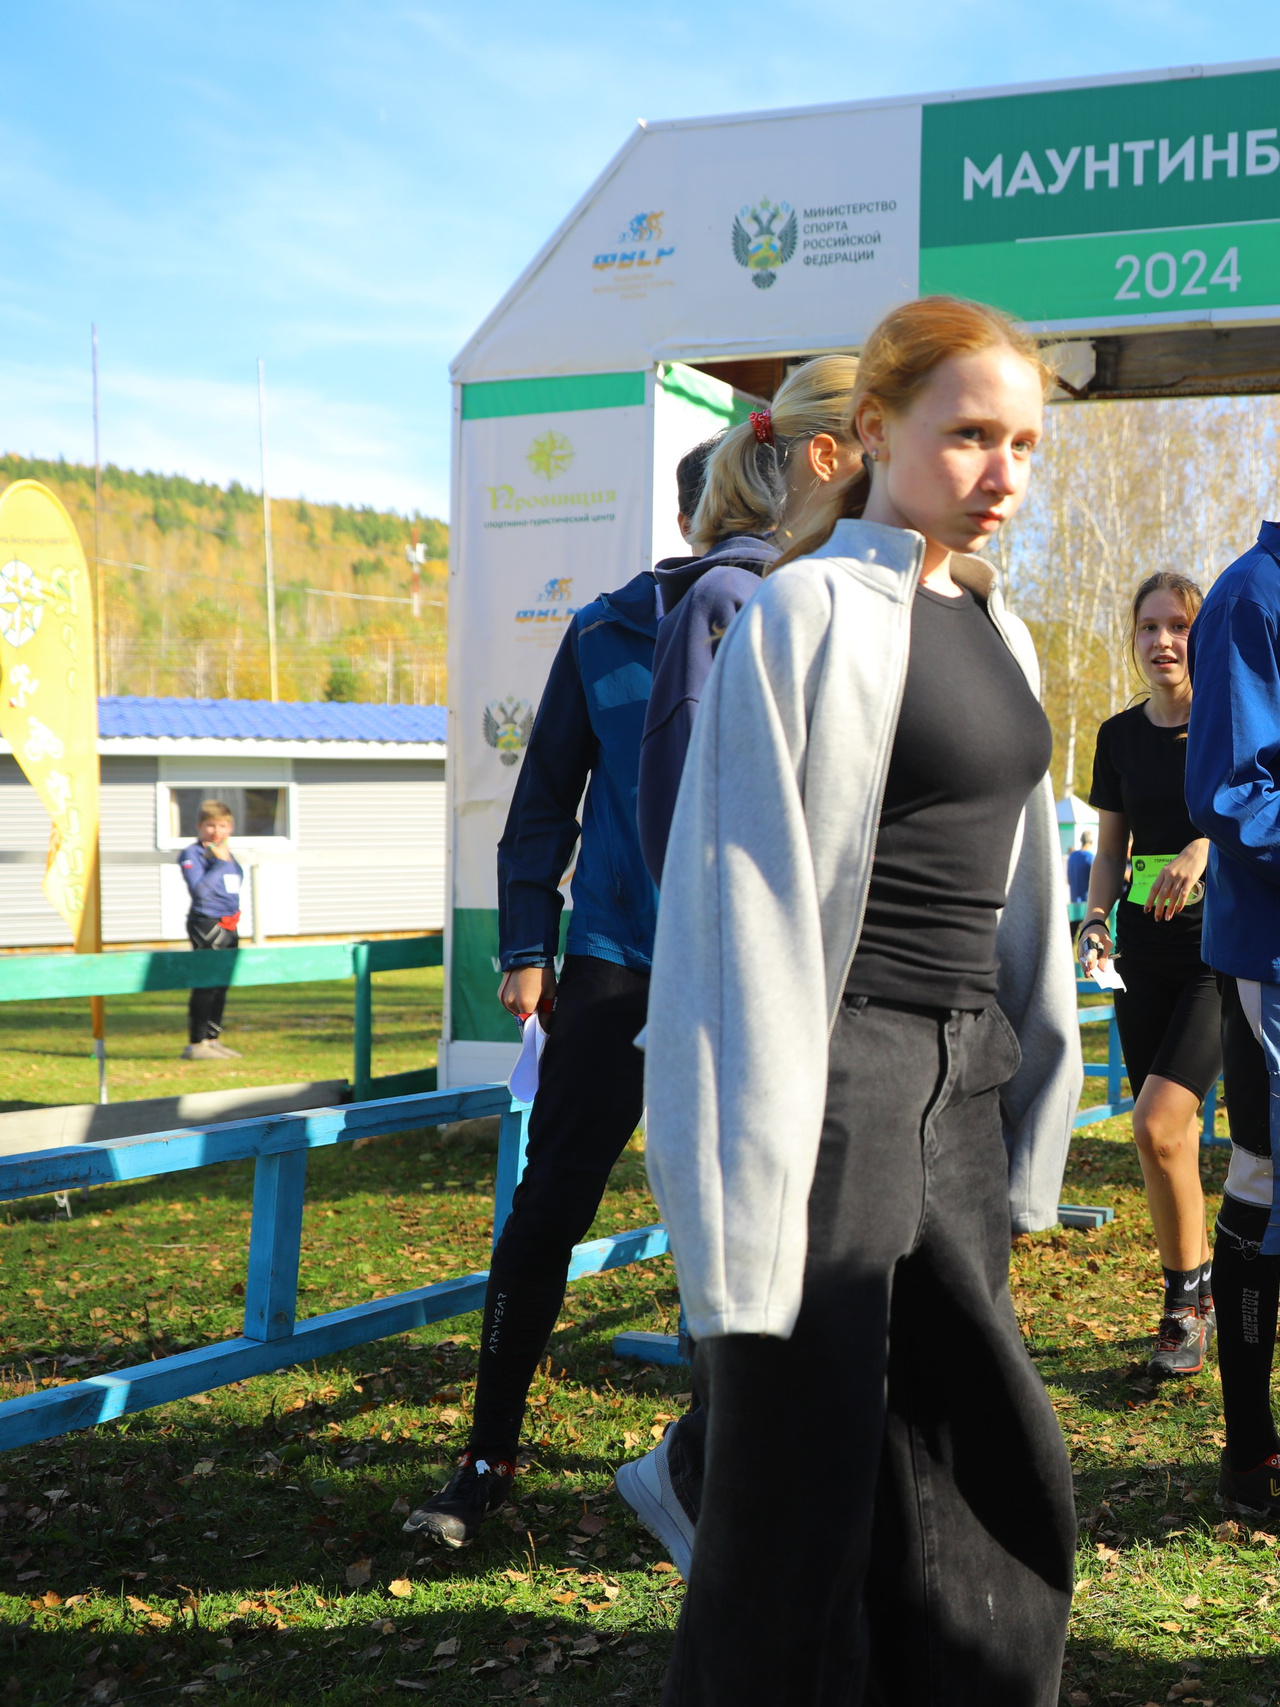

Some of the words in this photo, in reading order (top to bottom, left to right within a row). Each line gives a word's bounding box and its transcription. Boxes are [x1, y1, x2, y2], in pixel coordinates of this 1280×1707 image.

[803, 200, 897, 219] МИНИСТЕРСТВО
[803, 220, 848, 235] СПОРТА
[803, 230, 881, 250] РОССИЙСКОЙ
[803, 249, 874, 267] ФЕДЕРАЦИИ
[1114, 247, 1241, 300] 2024
